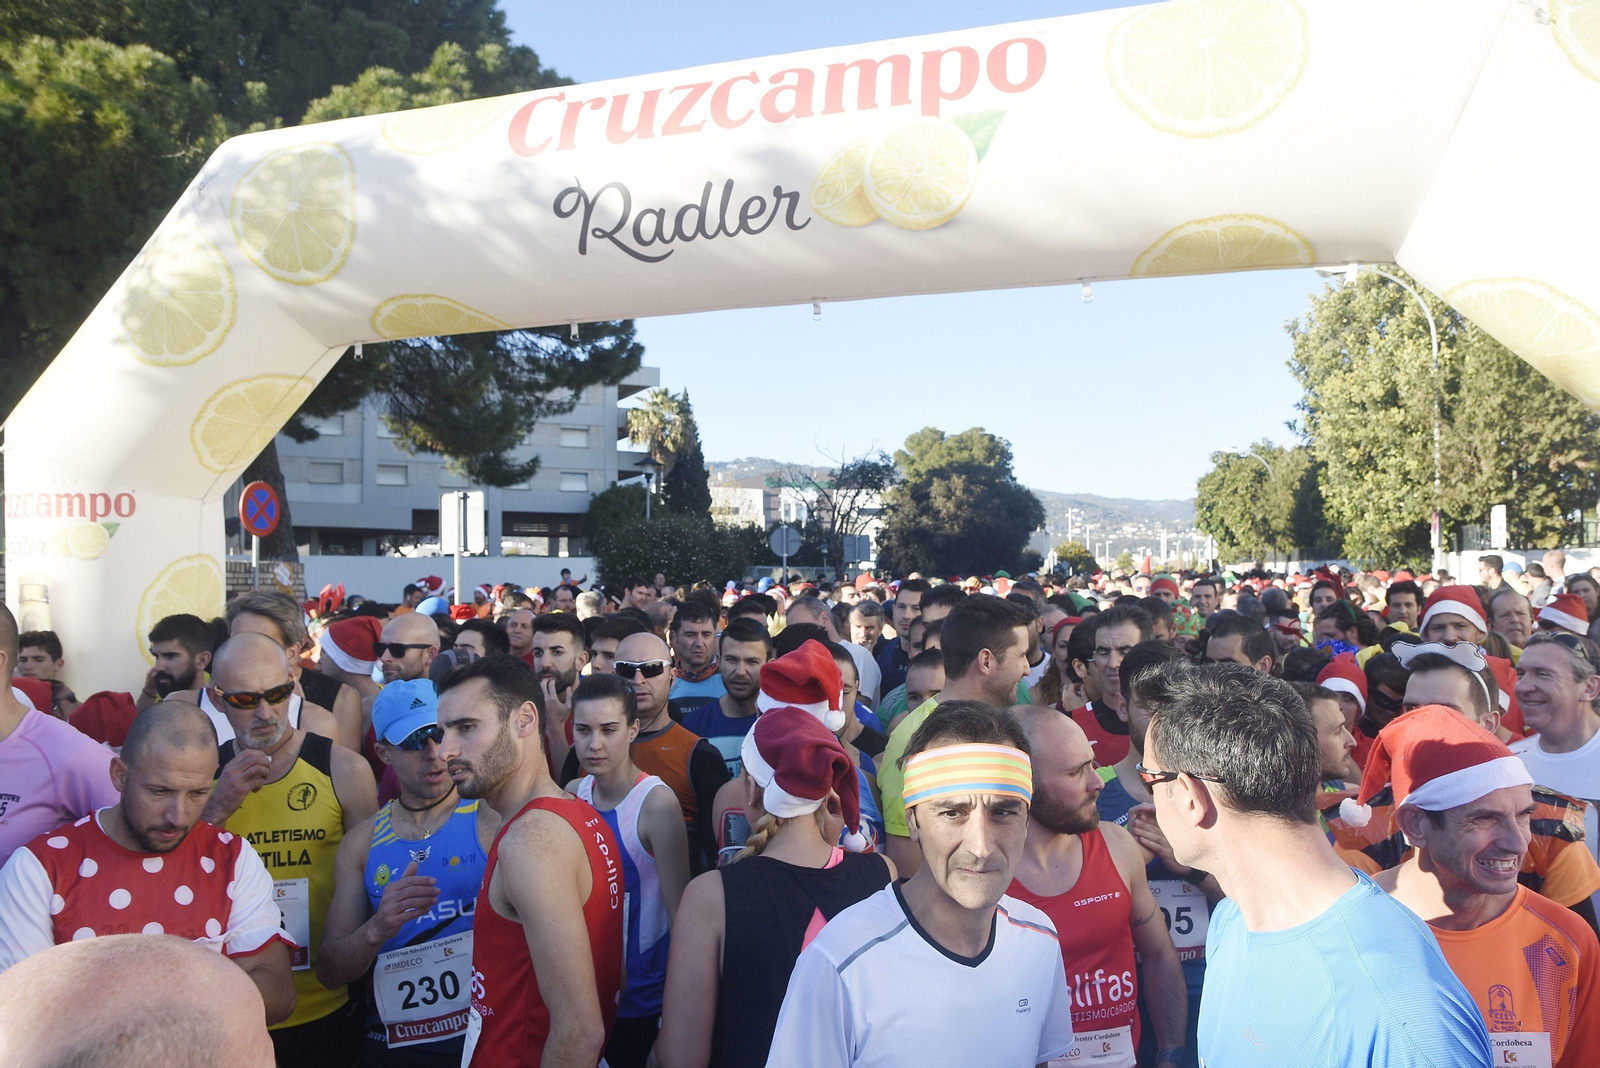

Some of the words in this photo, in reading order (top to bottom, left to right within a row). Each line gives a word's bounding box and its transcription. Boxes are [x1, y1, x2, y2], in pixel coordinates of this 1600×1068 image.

[507, 37, 1047, 157] Cruzcampo
[553, 176, 811, 263] Radler
[246, 829, 326, 845] ATLETISMO
[258, 849, 312, 869] TILLA
[397, 970, 460, 1010] 230
[395, 1012, 470, 1039] Cruzcampo
[1094, 1032, 1120, 1041] Cordobesa
[1490, 1039, 1533, 1047] Cordobesa
